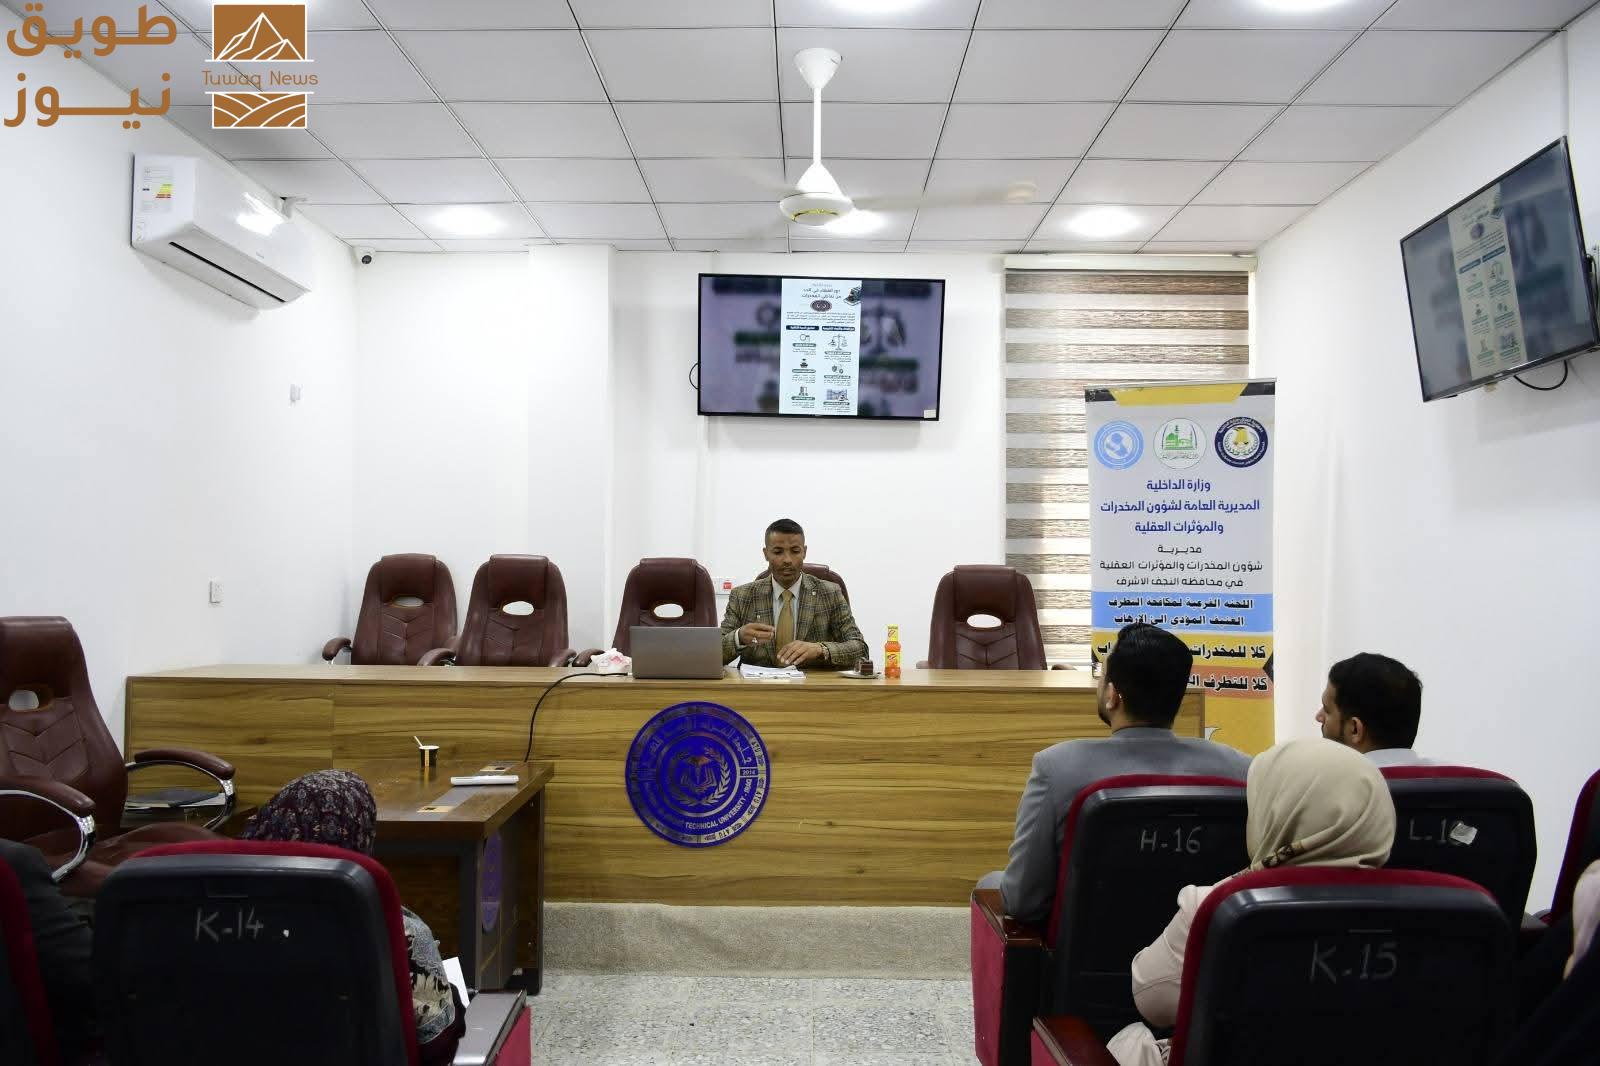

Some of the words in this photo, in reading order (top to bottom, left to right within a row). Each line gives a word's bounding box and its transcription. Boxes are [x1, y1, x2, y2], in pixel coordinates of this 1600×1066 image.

[1146, 479, 1185, 493] الداخلية
[1187, 480, 1211, 492] وزارة
[1100, 500, 1145, 514] المخدرات
[1146, 499, 1182, 513] لشؤون
[1184, 499, 1216, 512] العامة
[1218, 499, 1260, 513] المديرية
[1134, 520, 1171, 534] العقلية
[1173, 520, 1224, 534] والمؤثرات
[1100, 560, 1135, 570] العقلية
[1138, 560, 1185, 571] والمؤثرات
[1186, 561, 1231, 571] المخدرات
[1232, 560, 1263, 572] شؤون
[1116, 576, 1149, 587] الاشرف
[1151, 576, 1180, 587] النجف
[1225, 578, 1243, 589] في
[1108, 597, 1143, 608] التطرف
[1186, 597, 1221, 610] الفرعية
[1209, 616, 1244, 626] العنيف
[1189, 643, 1247, 660] للمخدرات
[1250, 645, 1266, 659] كلا
[1203, 674, 1249, 692] للتطرف
[1252, 677, 1268, 691] كلا
[685, 819, 719, 830] TECHNICAL
[717, 796, 747, 825] UNIVERSITY
[194, 907, 265, 942] K-14
[1308, 939, 1399, 984] K-15
